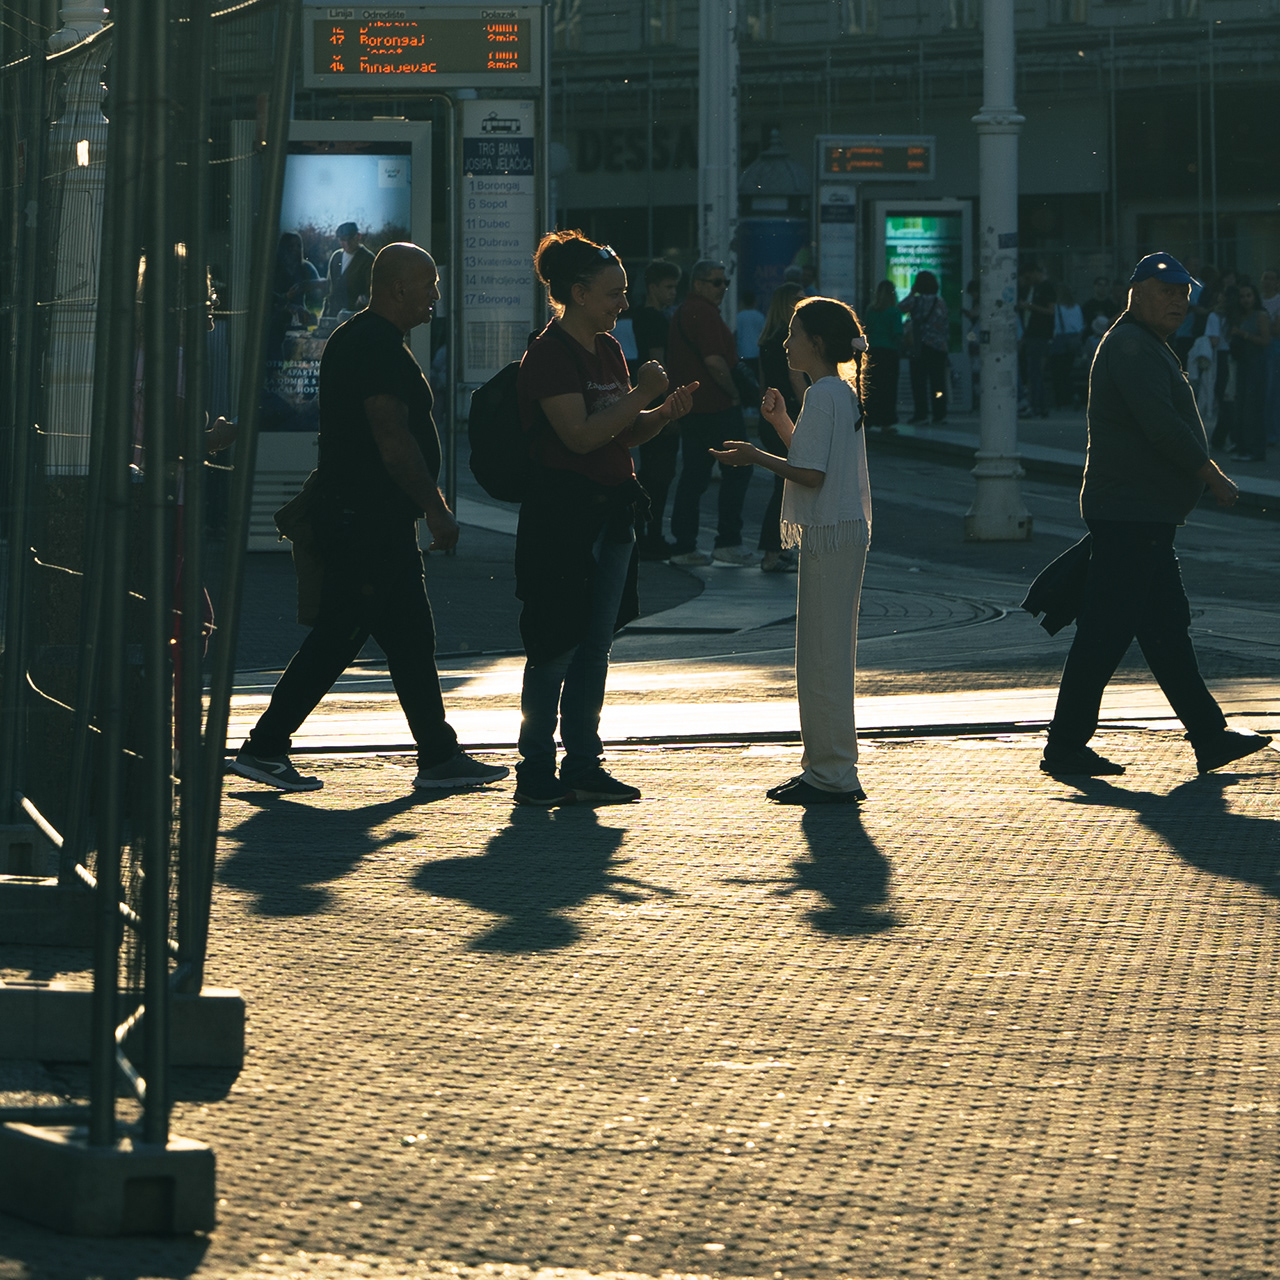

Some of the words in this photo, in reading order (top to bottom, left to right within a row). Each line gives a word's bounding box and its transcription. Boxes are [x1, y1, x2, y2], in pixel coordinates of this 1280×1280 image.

[329, 10, 353, 20] Linija
[362, 10, 405, 19] Odredište
[481, 10, 517, 19] Dolazak
[329, 34, 345, 45] 17
[478, 142, 496, 156] TRG
[498, 142, 521, 156] BANA
[465, 157, 493, 171] JOSIPA
[495, 155, 532, 170] JELAČIĆA
[469, 181, 475, 191] 1
[477, 180, 521, 192] Borongaj
[468, 199, 476, 210] 6
[479, 199, 508, 210] Sopot
[465, 218, 476, 229] 11
[479, 219, 511, 229] Dubec
[465, 237, 477, 249] 12
[478, 237, 520, 248] Dubrava
[464, 256, 477, 268] 13
[477, 257, 522, 267] Kvaternikov
[465, 274, 477, 286] 14
[480, 275, 531, 287] Mihaljevac
[465, 294, 477, 306] 17
[478, 294, 521, 306] Borongaj
